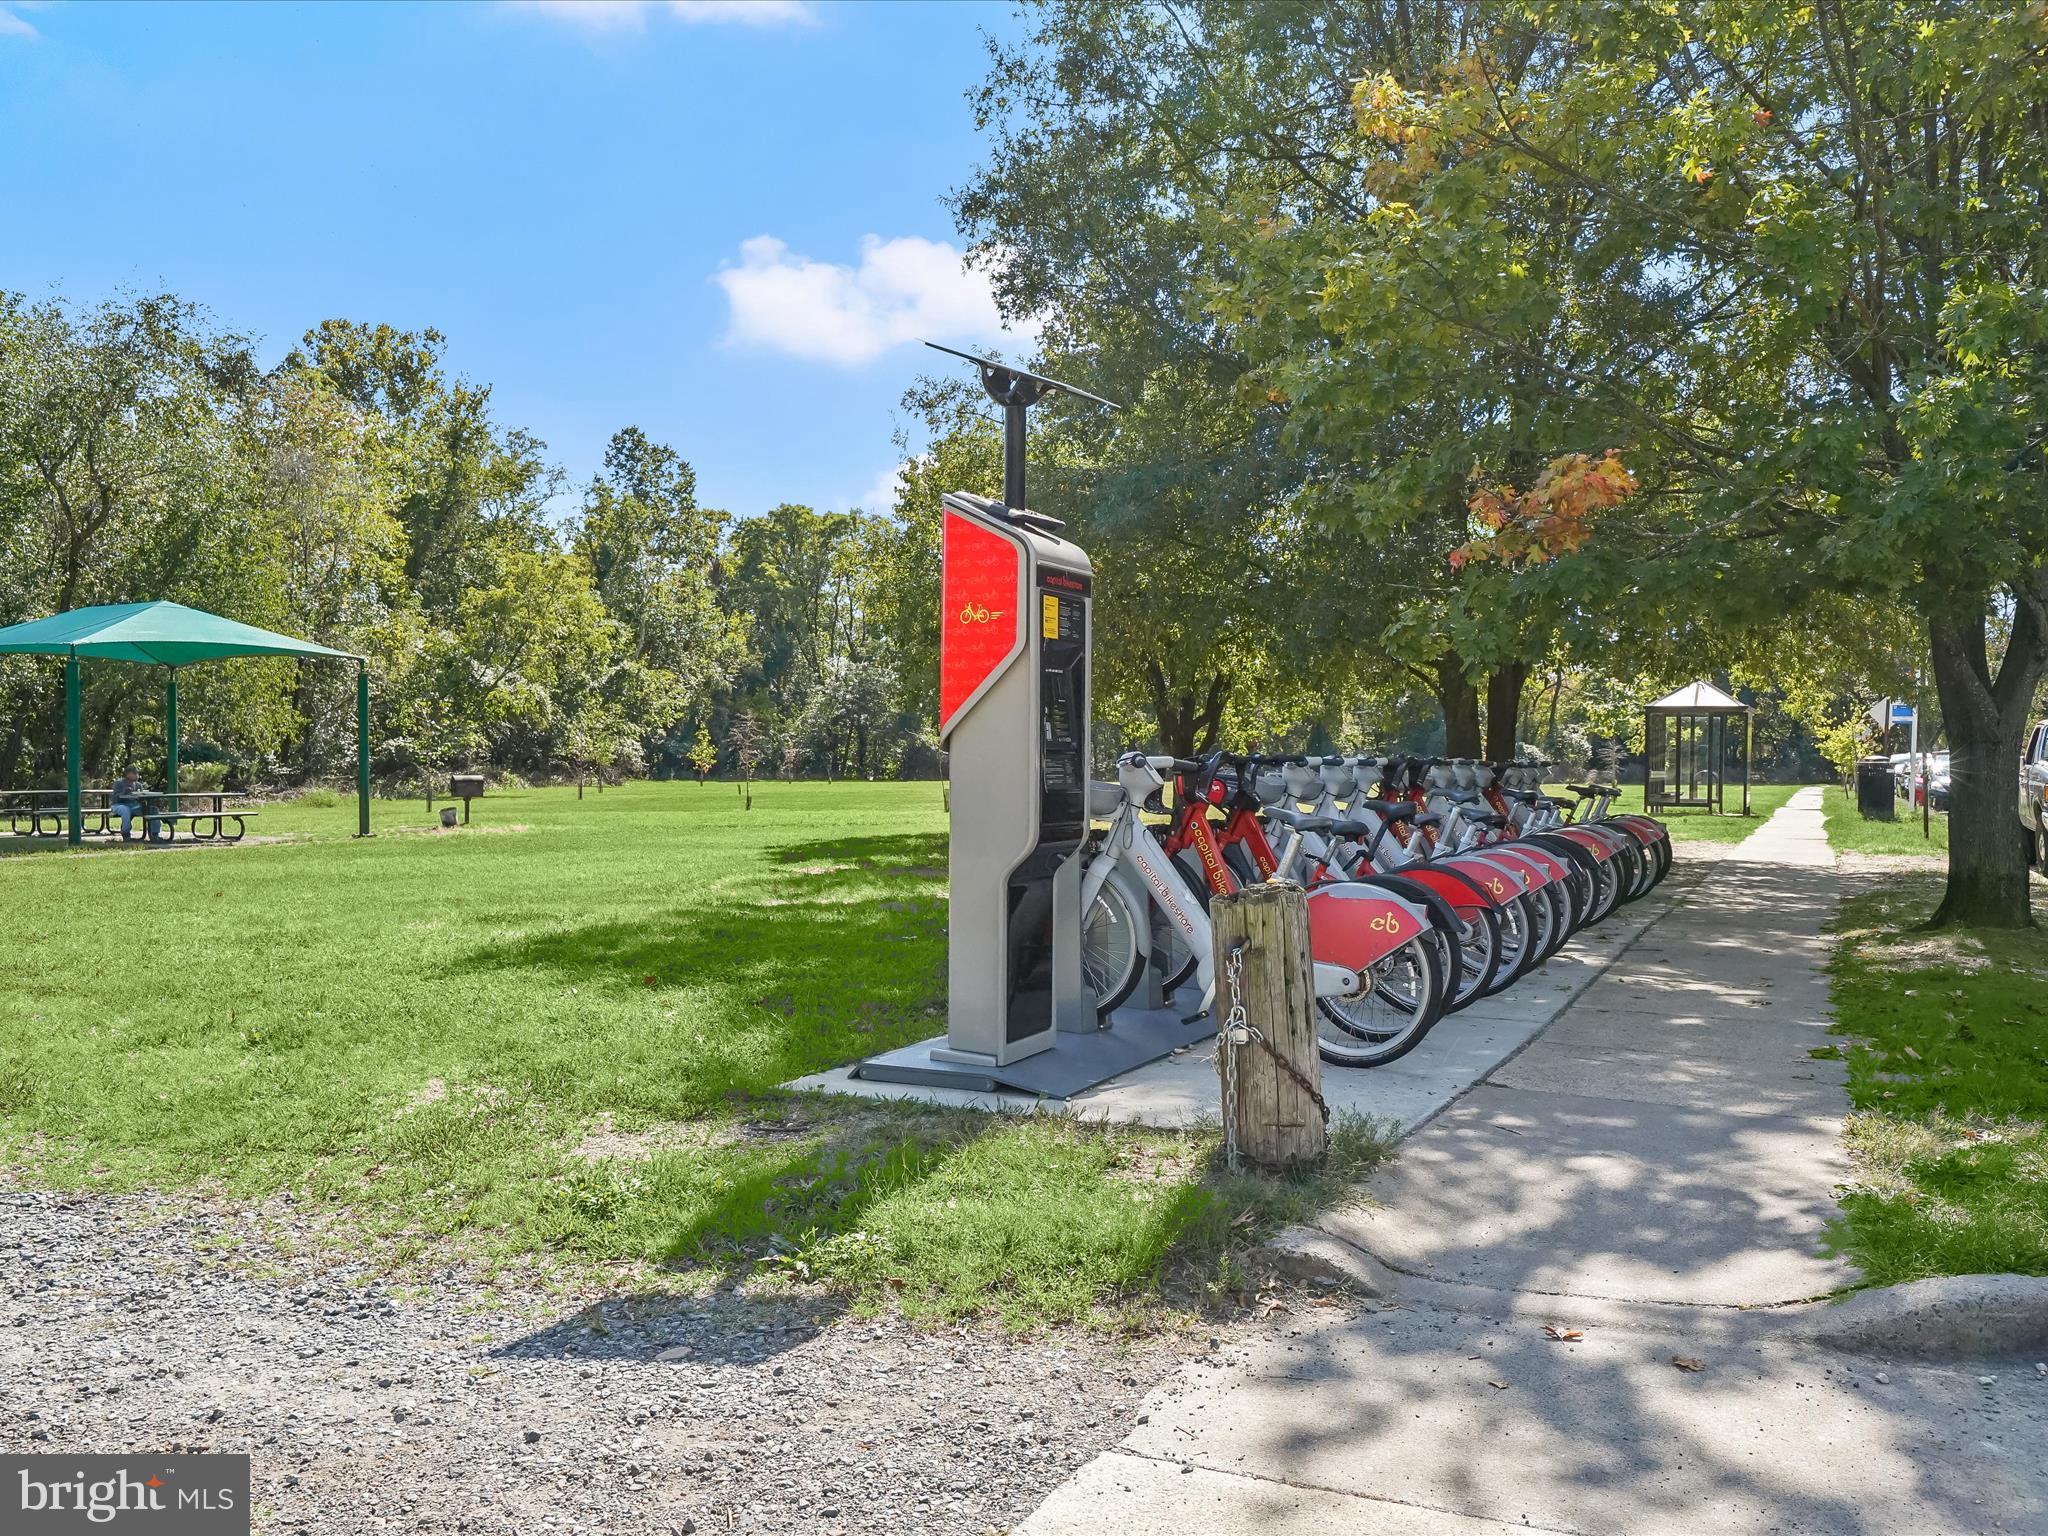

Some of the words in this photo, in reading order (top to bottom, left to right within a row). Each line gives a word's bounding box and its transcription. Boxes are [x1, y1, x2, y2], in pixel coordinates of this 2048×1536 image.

[1136, 855, 1163, 889] capital
[1161, 886, 1194, 934] bikeshare
[1194, 829, 1219, 869] capital
[1212, 869, 1229, 897] bike
